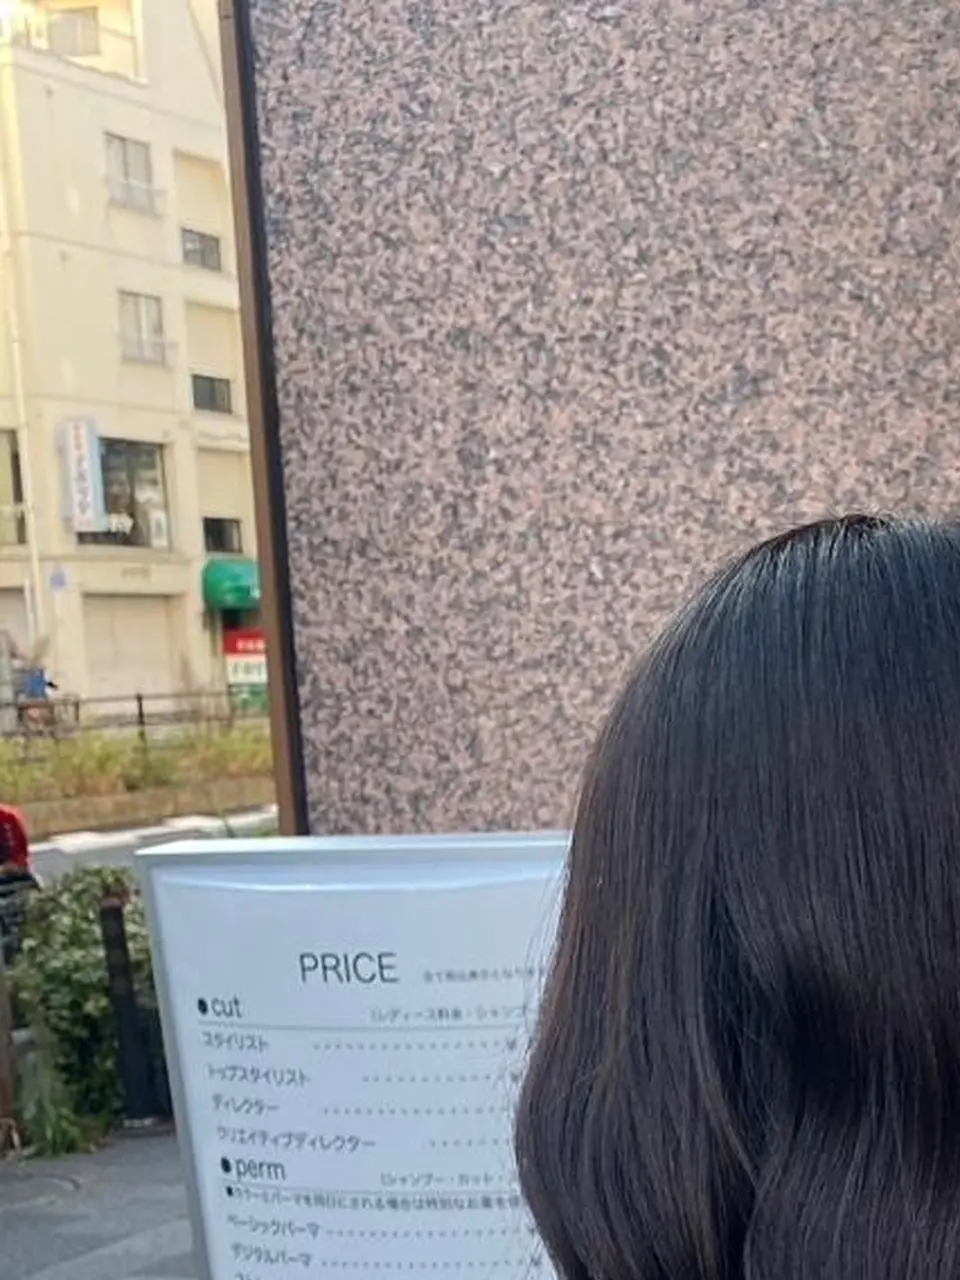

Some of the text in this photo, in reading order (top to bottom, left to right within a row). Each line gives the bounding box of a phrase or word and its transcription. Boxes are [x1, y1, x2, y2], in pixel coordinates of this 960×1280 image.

[298, 952, 400, 984] PRICE
[211, 997, 243, 1019] cut
[202, 1032, 270, 1054] スタイリスト
[206, 1063, 312, 1088] トップスタイリスト
[212, 1093, 281, 1116] ディレクター
[216, 1126, 378, 1153] クリエイティブディレクター
[235, 1156, 287, 1181] perm
[226, 1213, 321, 1240] ベーシックパーマ
[231, 1242, 313, 1268] デジタルパーマ
